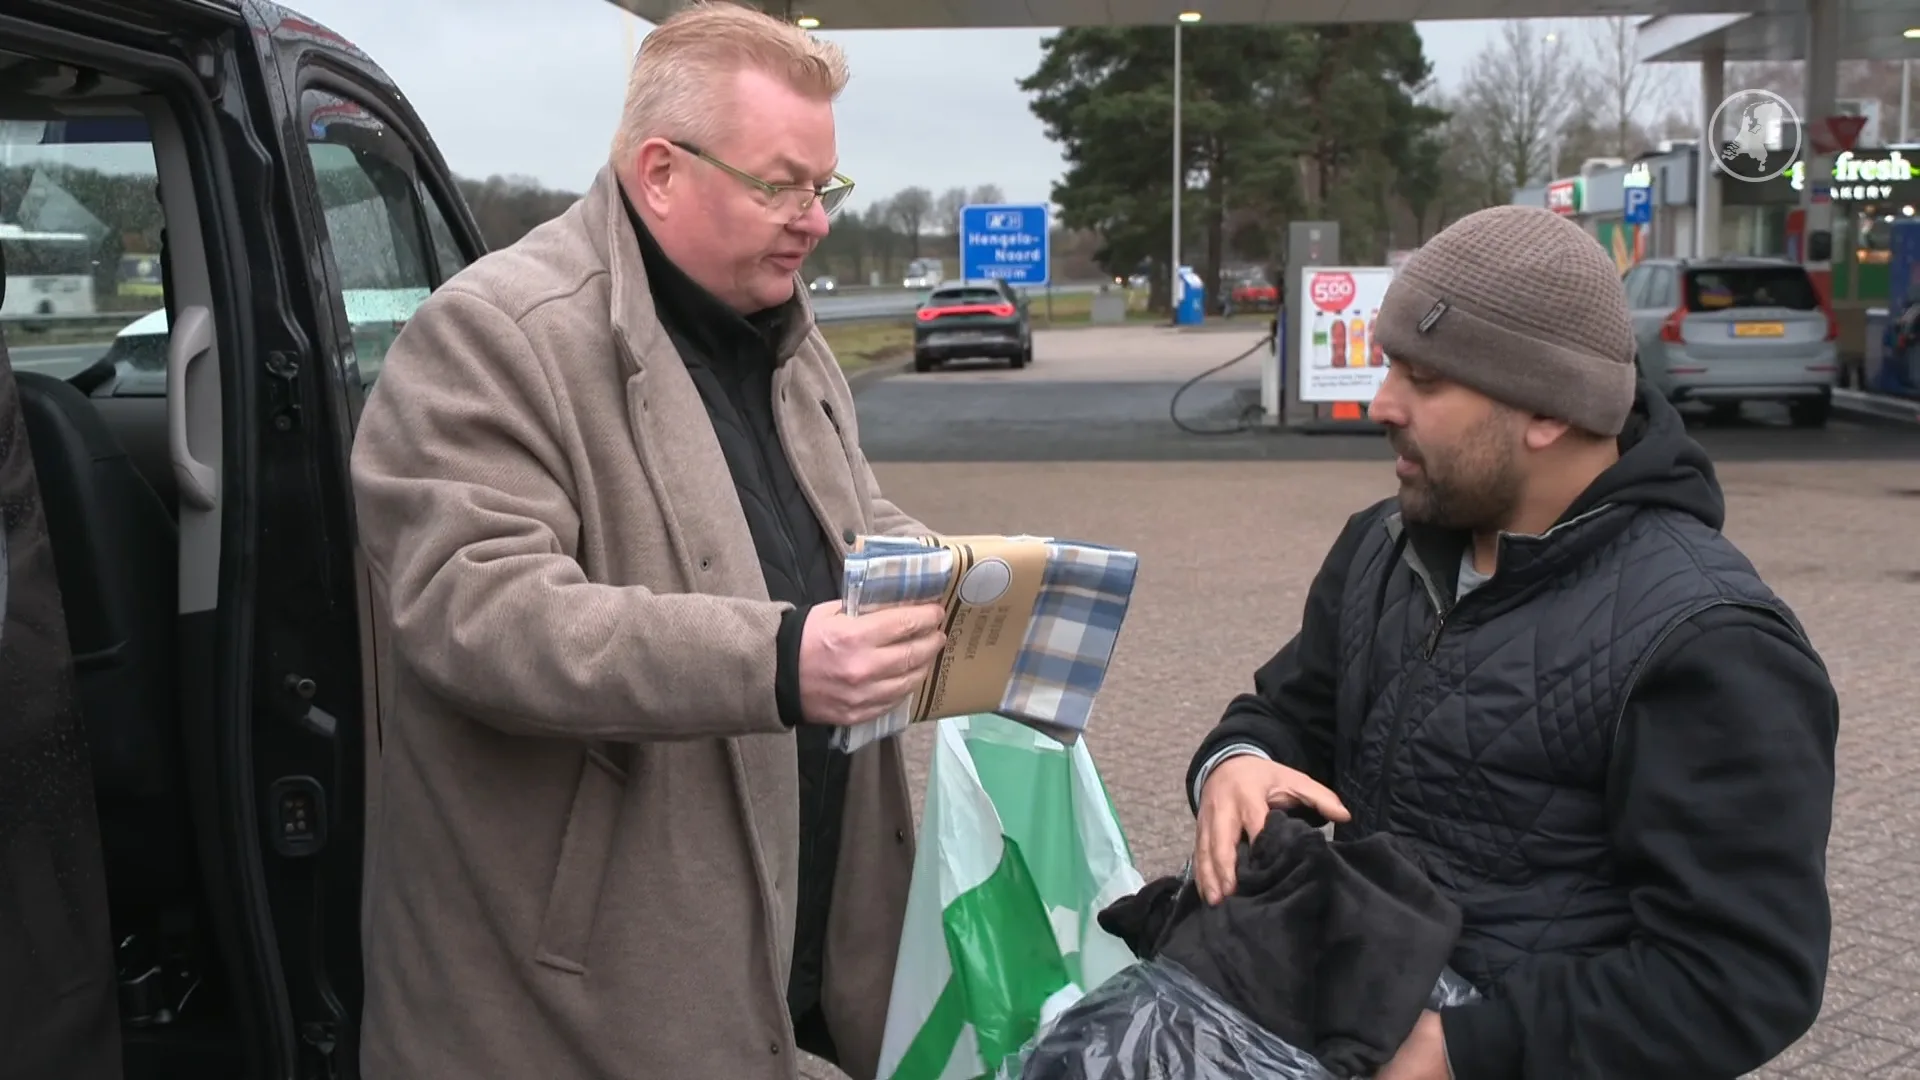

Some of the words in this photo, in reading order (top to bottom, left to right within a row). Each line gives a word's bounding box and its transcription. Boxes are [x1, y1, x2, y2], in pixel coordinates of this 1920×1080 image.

[1835, 151, 1912, 181] fresh
[1627, 189, 1648, 216] P
[1830, 186, 1892, 200] AKERY
[969, 232, 1040, 247] Hengelo-
[995, 247, 1041, 262] Noord
[954, 606, 972, 631] Ten
